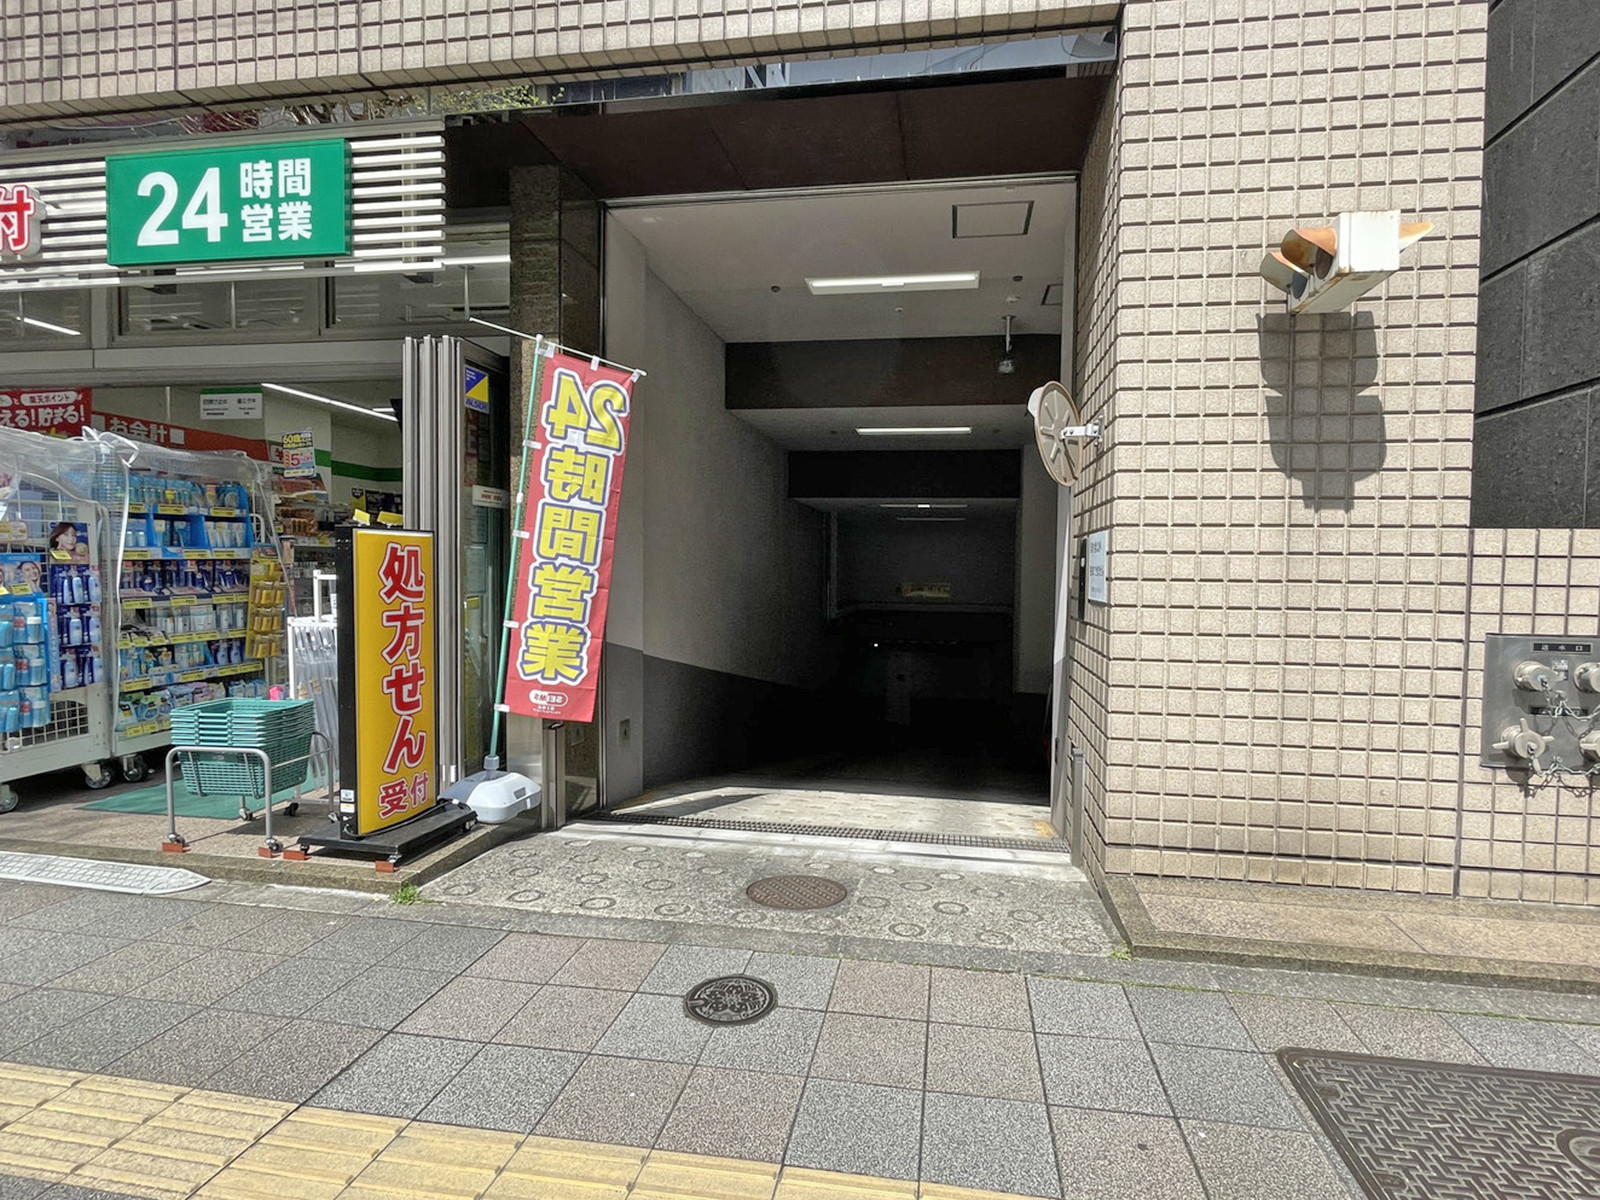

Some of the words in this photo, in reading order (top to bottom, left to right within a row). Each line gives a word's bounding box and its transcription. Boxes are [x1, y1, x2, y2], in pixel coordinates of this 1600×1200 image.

[240, 158, 311, 199] 時間
[137, 167, 228, 247] 24
[241, 201, 312, 242] 営業
[109, 416, 168, 443] お会計
[378, 542, 426, 775] 処方せん
[378, 771, 428, 819] 受付
